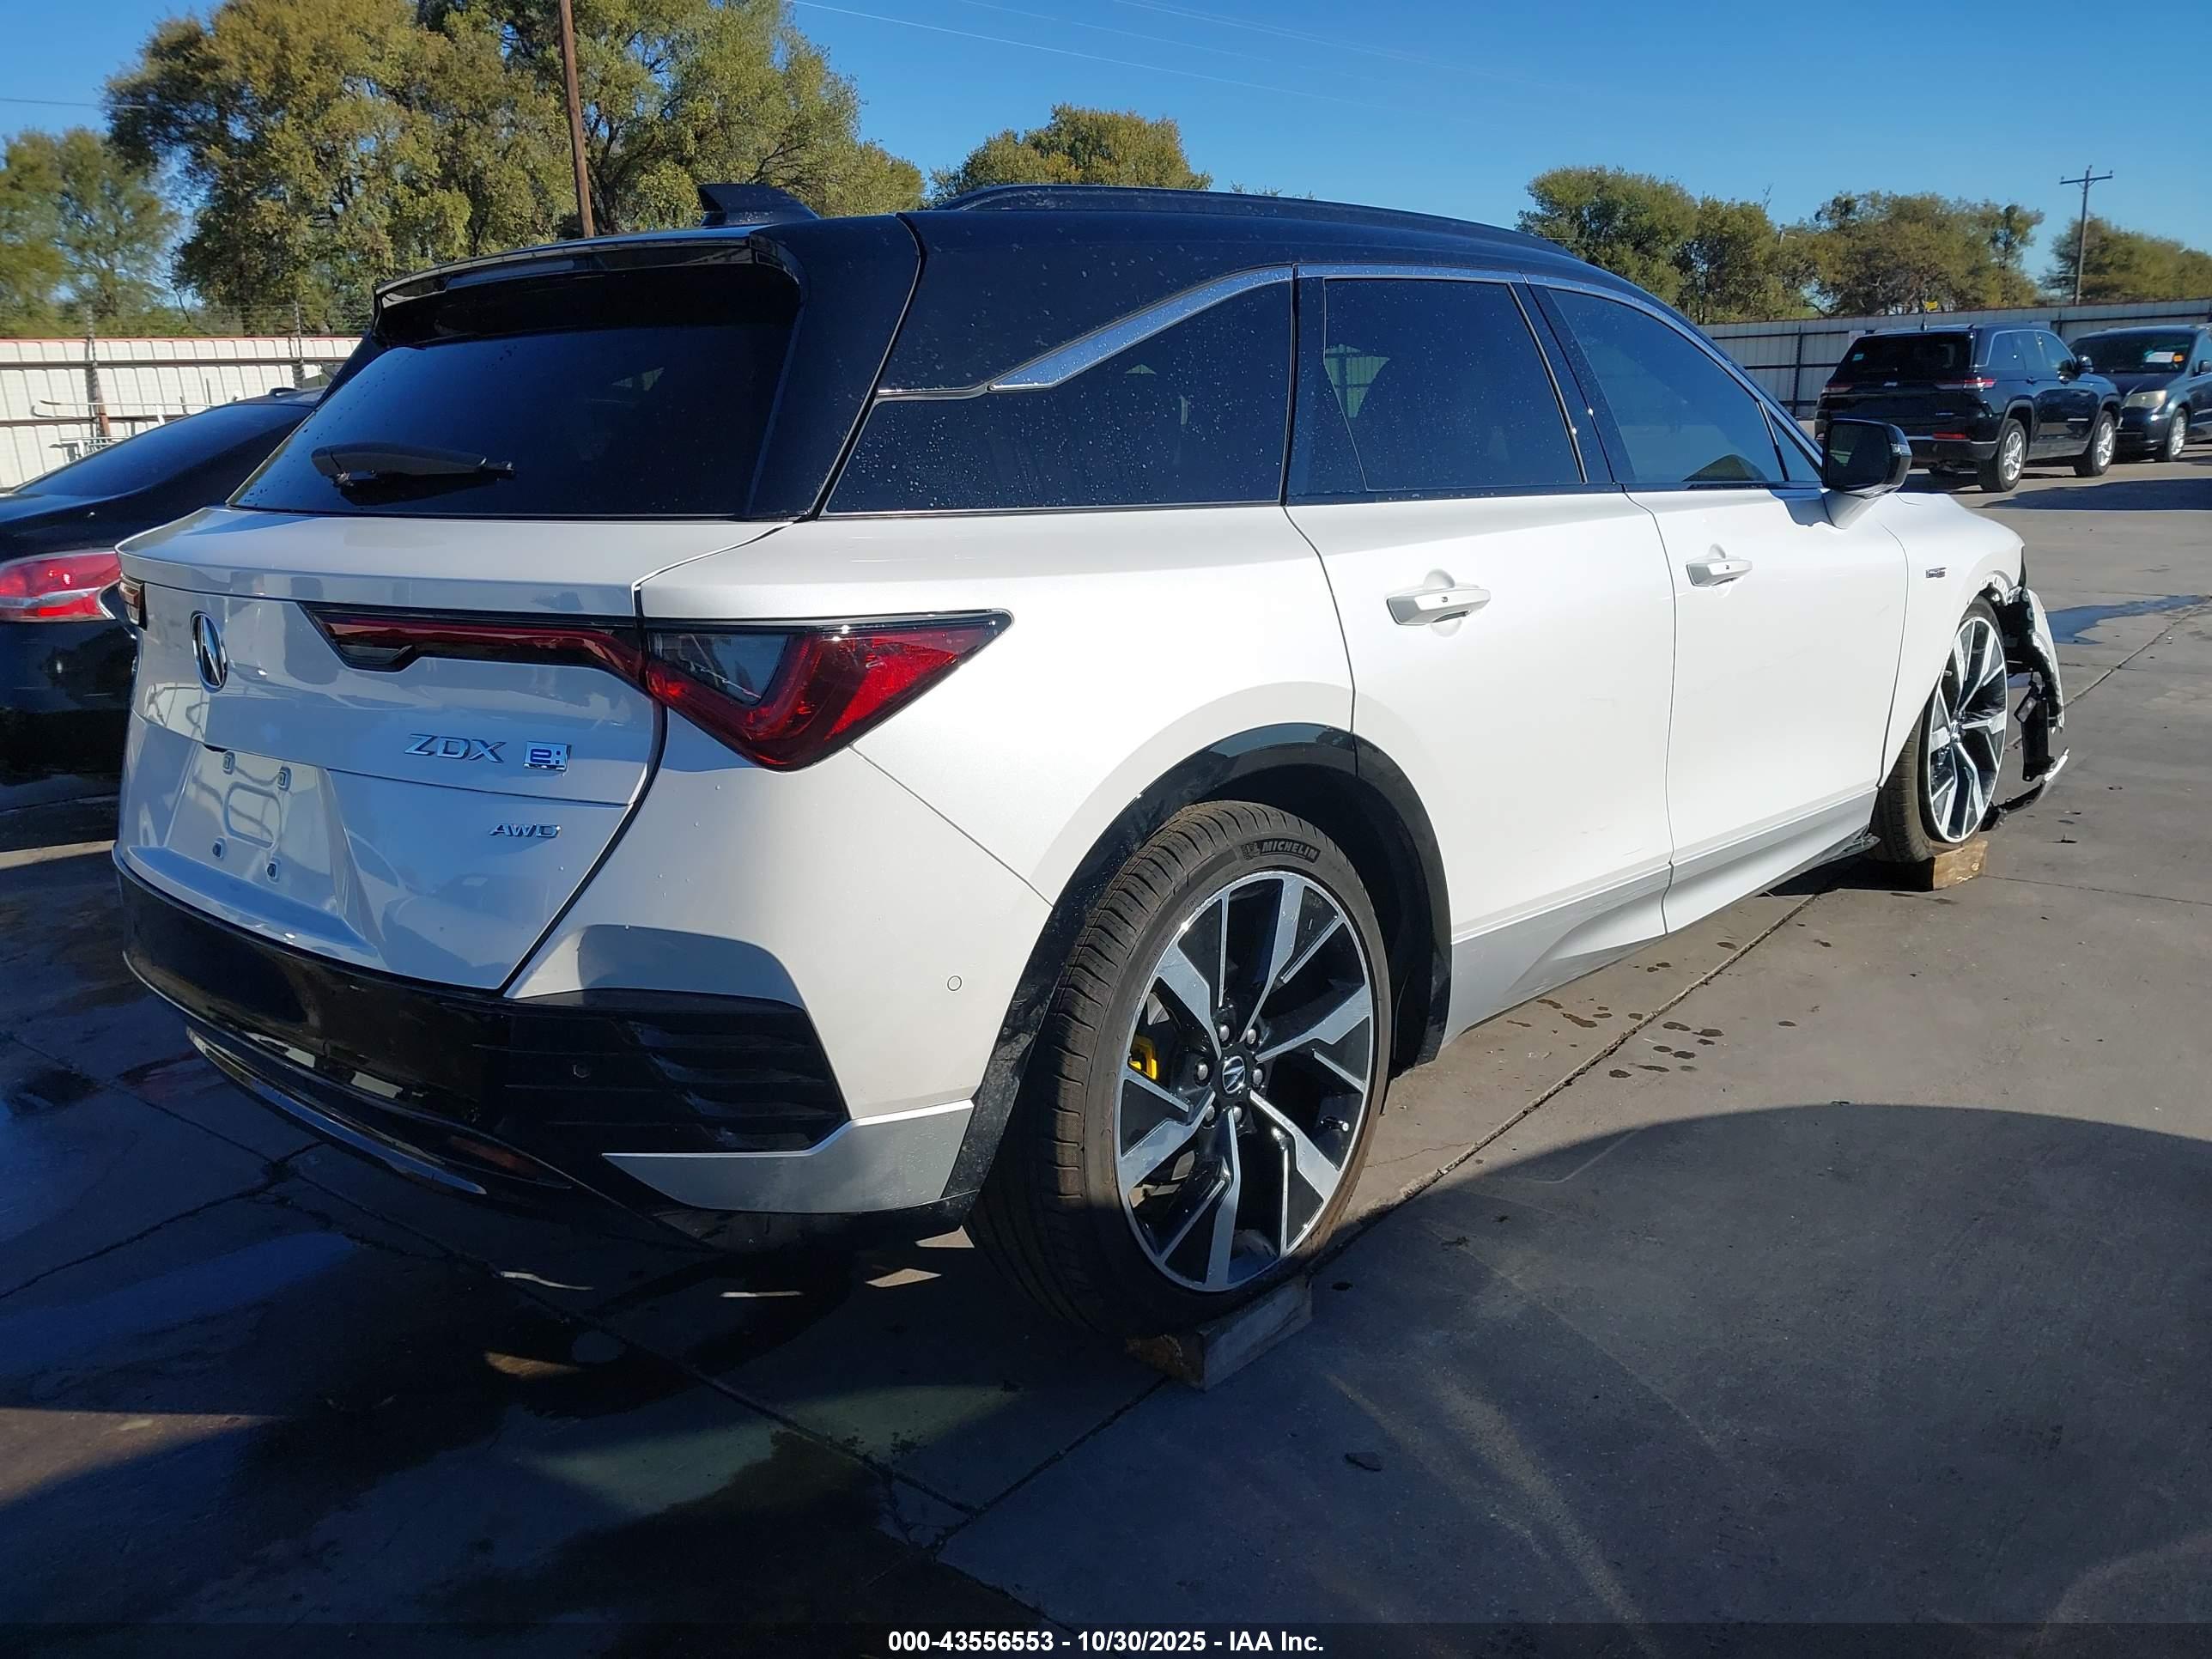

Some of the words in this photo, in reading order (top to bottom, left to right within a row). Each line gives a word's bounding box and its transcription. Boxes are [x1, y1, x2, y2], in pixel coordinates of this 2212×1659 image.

[404, 733, 507, 763] ZDX
[488, 823, 562, 839] AWD
[1261, 841, 1318, 860] MICHELIN
